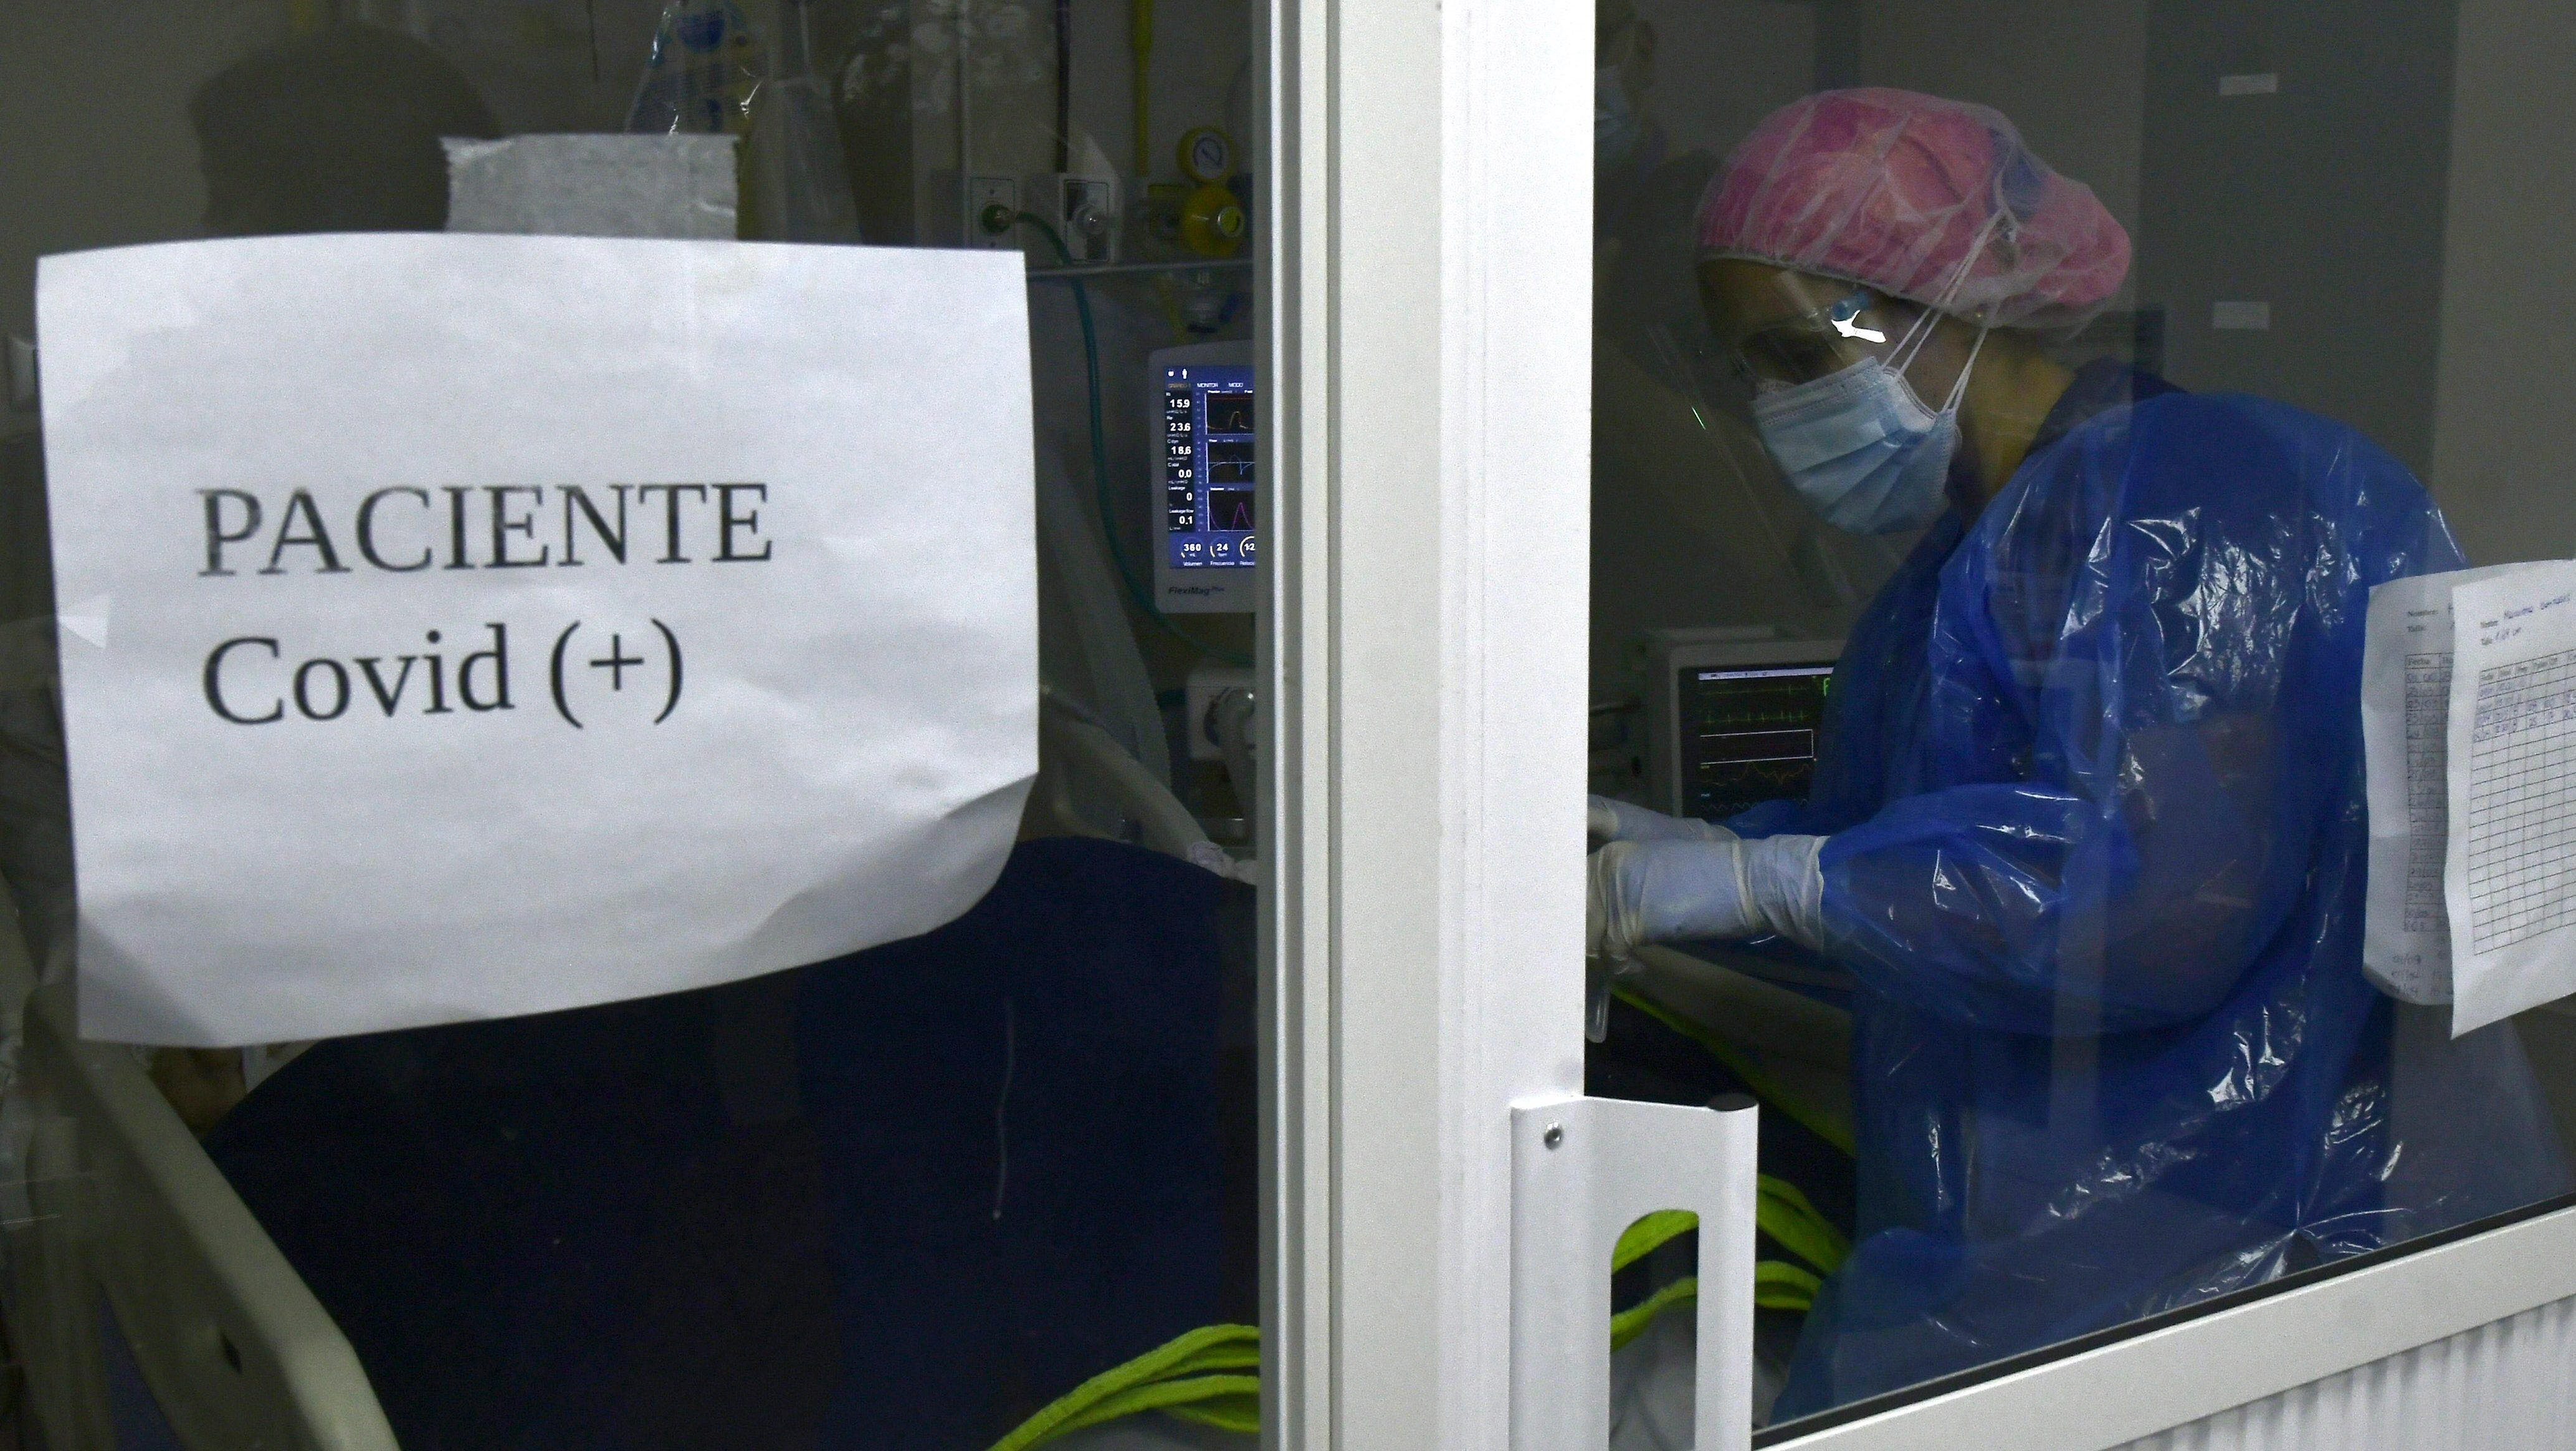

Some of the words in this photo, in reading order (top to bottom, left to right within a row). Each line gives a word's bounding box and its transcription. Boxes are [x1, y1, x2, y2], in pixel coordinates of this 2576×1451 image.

[1186, 492, 1193, 500] 0
[1179, 516, 1193, 525] 0.1
[198, 482, 773, 577] PACIENTE
[1183, 544, 1201, 552] 360
[203, 622, 515, 726] Covid
[550, 618, 684, 729] (+)
